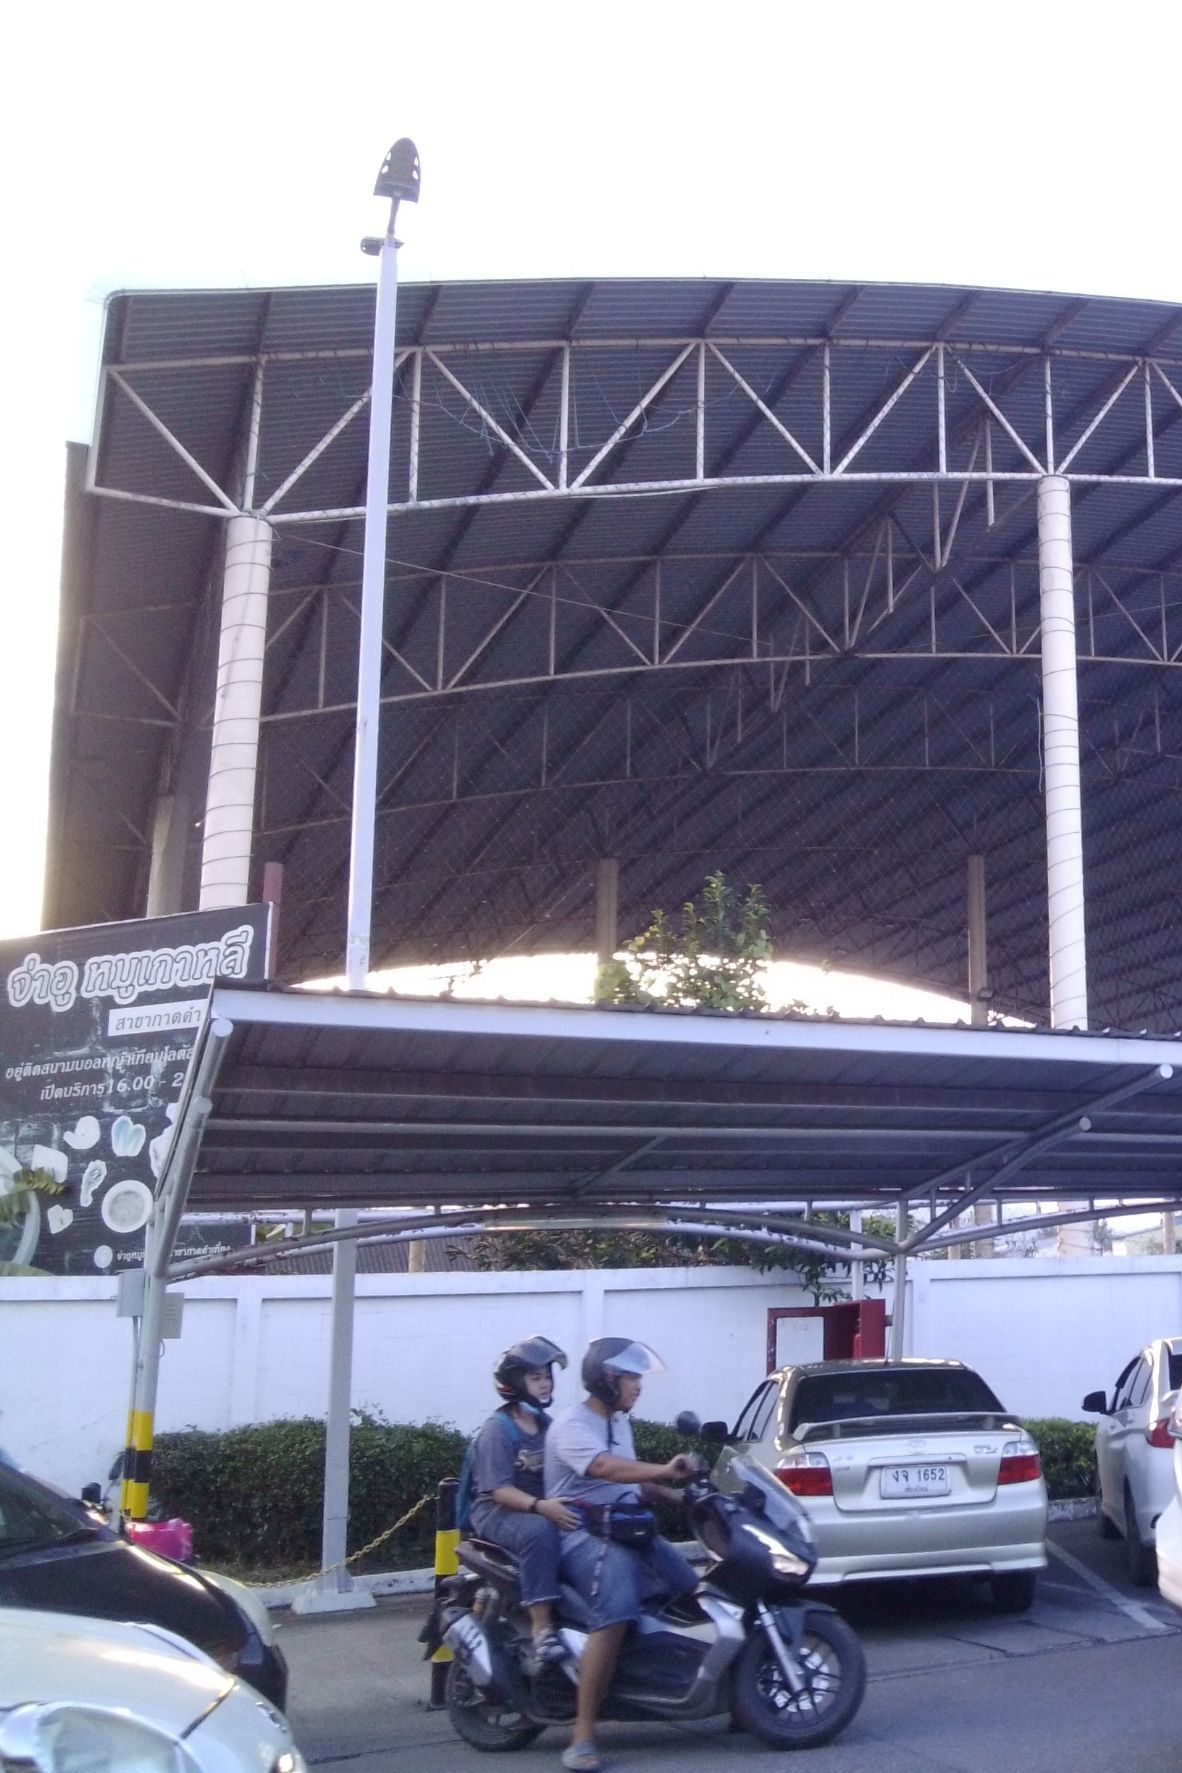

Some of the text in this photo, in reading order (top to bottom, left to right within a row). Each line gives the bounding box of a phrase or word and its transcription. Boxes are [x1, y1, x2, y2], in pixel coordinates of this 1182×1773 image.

[8, 924, 254, 1012] จ่าอู หมูเกาหลี
[918, 1468, 945, 1481] 1652
